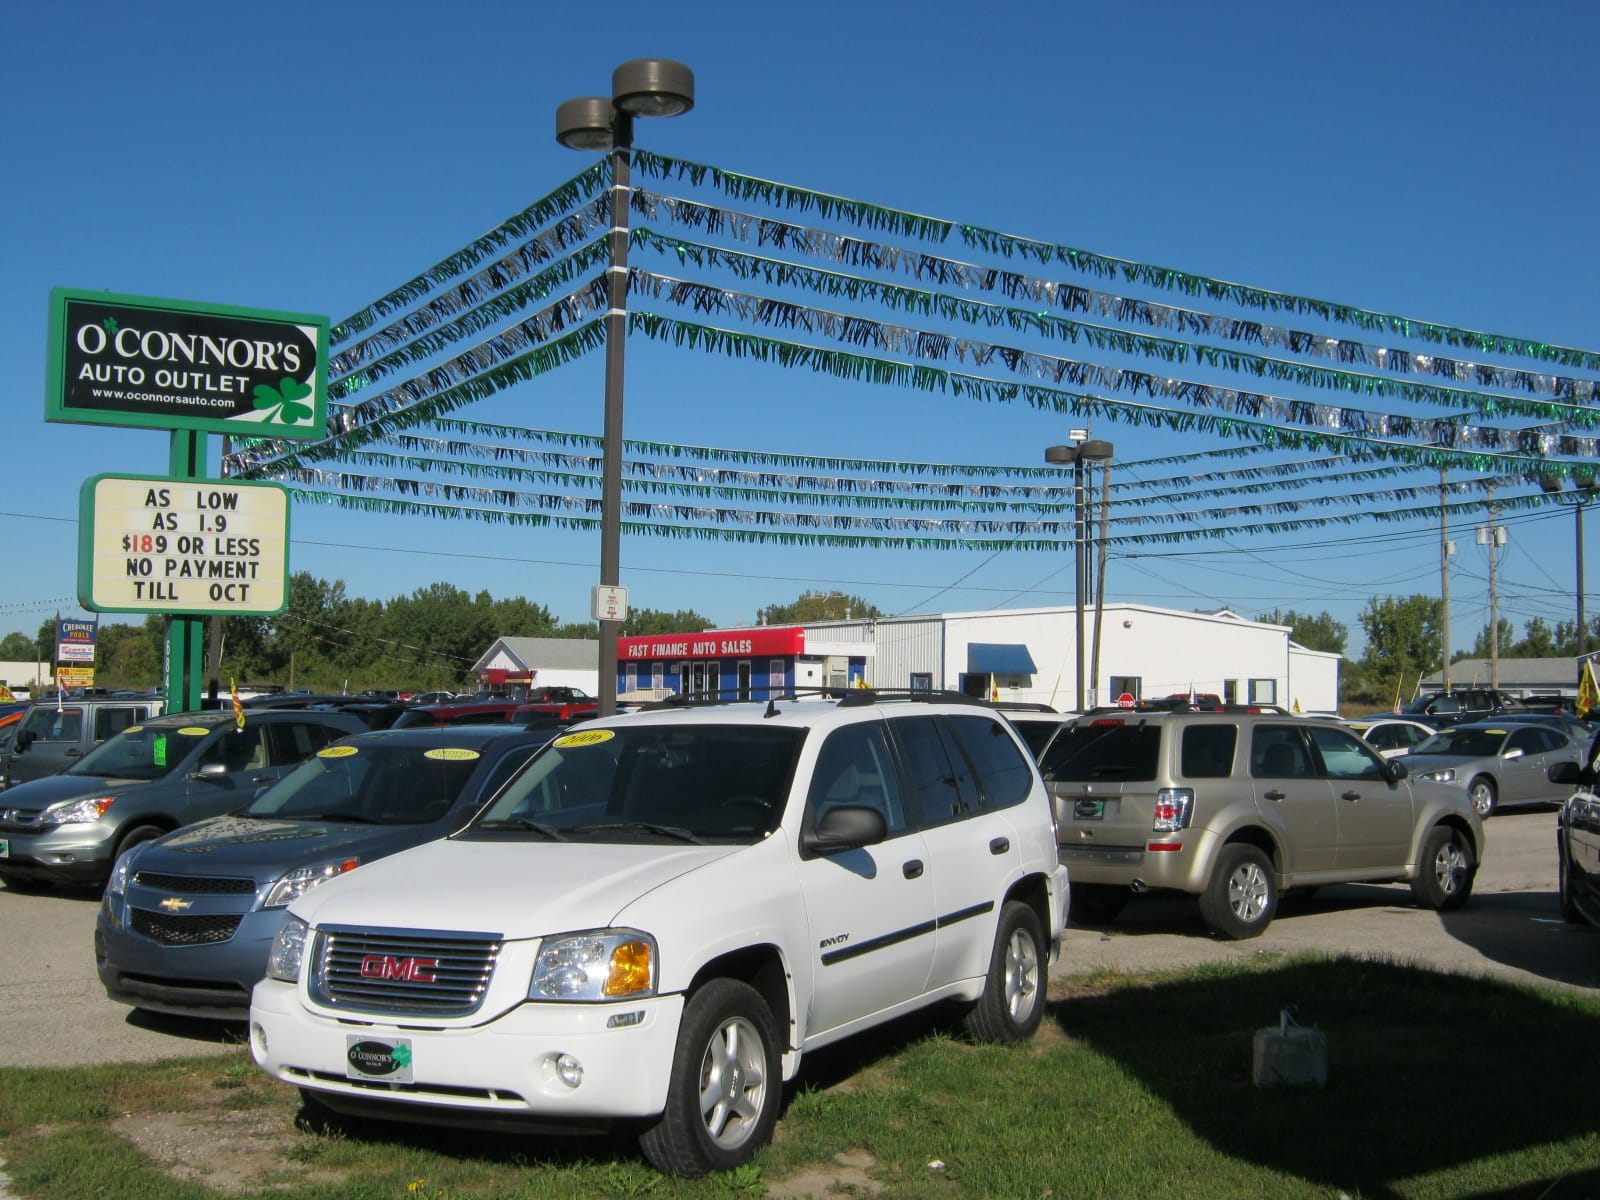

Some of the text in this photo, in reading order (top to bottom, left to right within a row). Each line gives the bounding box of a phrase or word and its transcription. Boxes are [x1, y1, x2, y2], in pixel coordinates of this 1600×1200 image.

[78, 362, 250, 394] AUTO OUTLET
[92, 388, 235, 408] www.oconnorsauto.com
[145, 488, 238, 510] AS LOW
[152, 512, 227, 532] AS 1.9
[122, 534, 260, 556] $189 OR LESS
[126, 558, 259, 579] NO PAYMENT
[133, 581, 250, 602] TILL OCT
[628, 639, 752, 657] FAST FINANCE AUTO SALES
[1119, 700, 1134, 708] STOP
[819, 932, 850, 948] ENVOY
[360, 956, 439, 983] GMC
